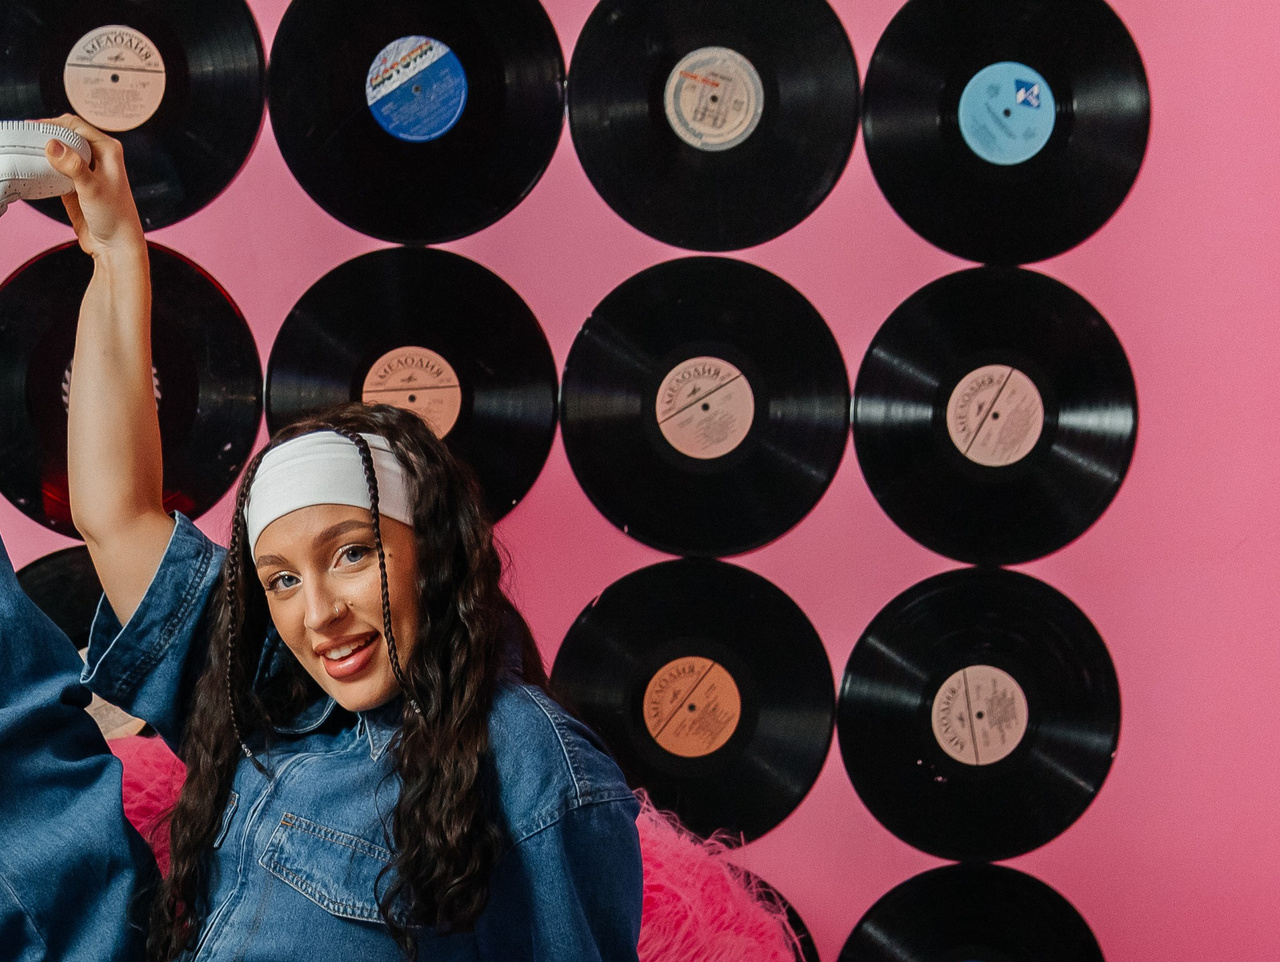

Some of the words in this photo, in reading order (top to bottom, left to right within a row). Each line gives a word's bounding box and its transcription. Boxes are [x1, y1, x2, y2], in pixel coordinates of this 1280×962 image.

[83, 35, 151, 60] МЕЛОДИЯ
[378, 357, 443, 379] МЕЛОДИЯ
[664, 364, 721, 405] МЕЛОДИЯ
